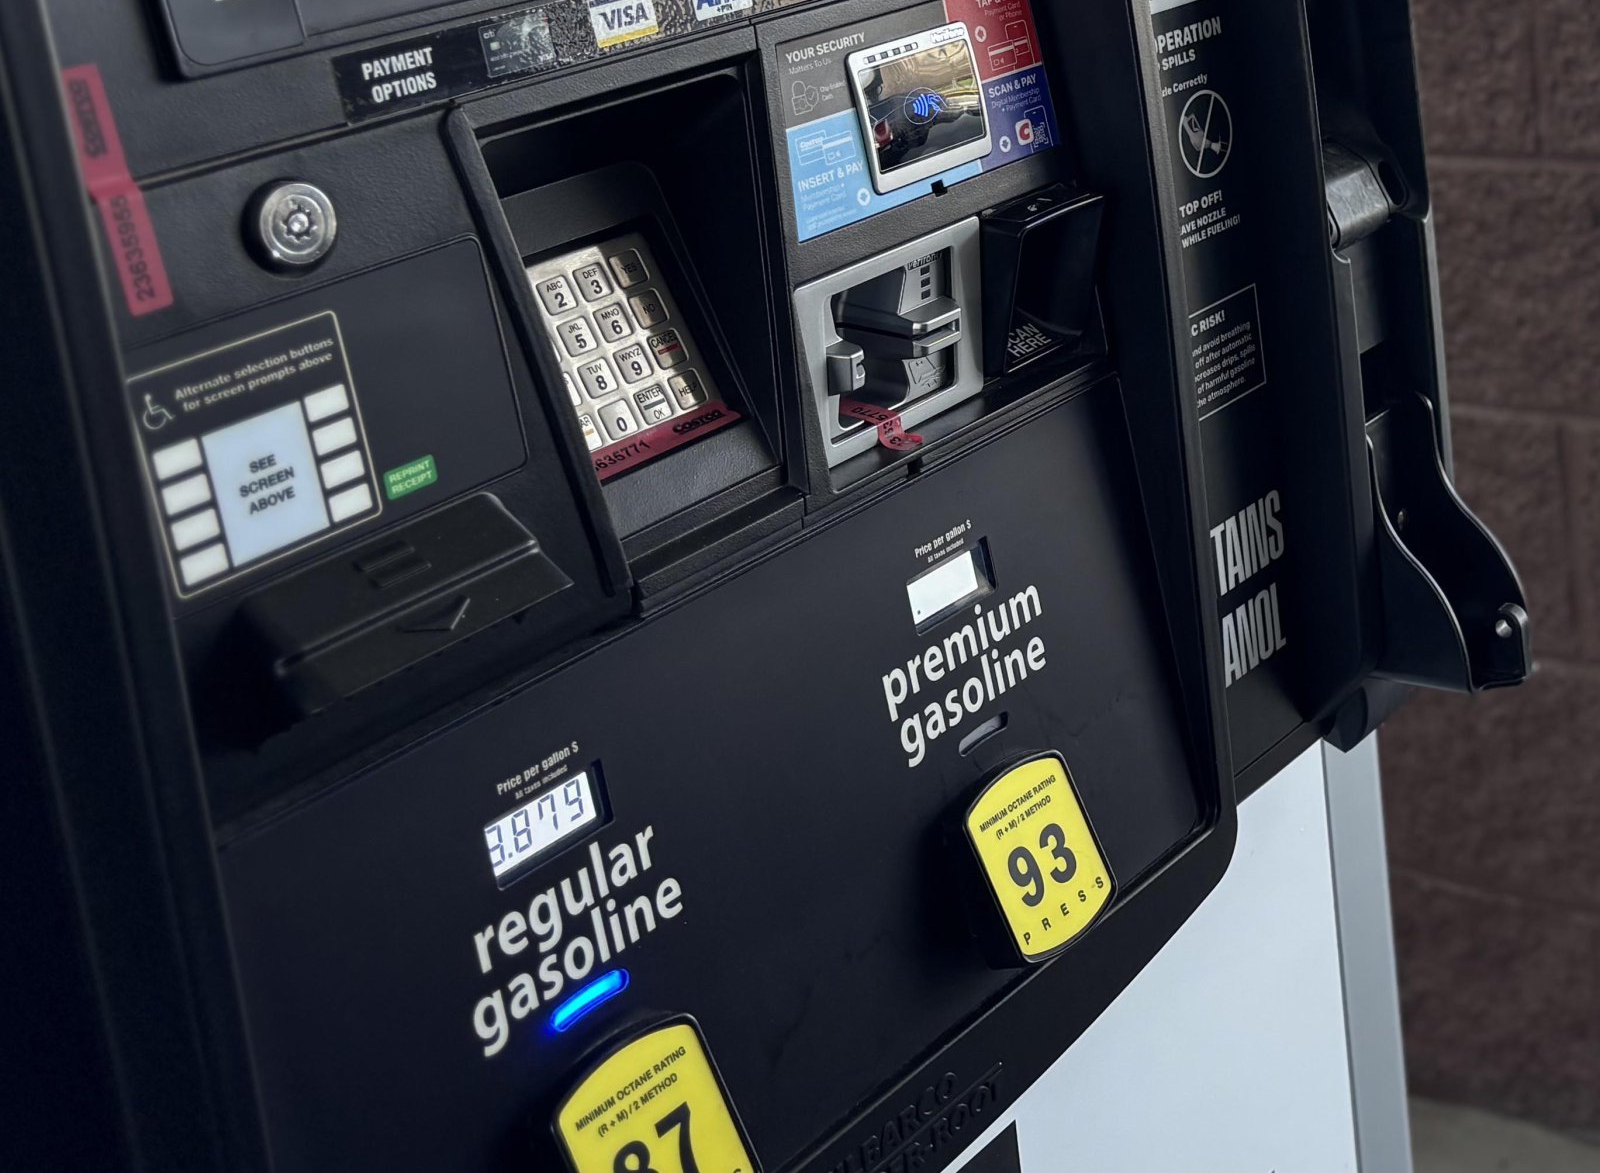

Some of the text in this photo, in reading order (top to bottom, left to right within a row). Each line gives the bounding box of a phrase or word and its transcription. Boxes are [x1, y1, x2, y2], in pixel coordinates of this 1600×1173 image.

[601, 1, 648, 34] VISA
[361, 47, 433, 80] PAYMENT
[785, 32, 866, 65] YOUR SECURITY
[1161, 48, 1196, 72] SPILLS
[371, 73, 437, 104] OPTIONS
[988, 73, 1037, 99] SCAN PAY
[1172, 73, 1208, 94] Correctly
[797, 160, 864, 193] INSERT & PAY
[1179, 189, 1223, 218] TOP OFF!
[1197, 207, 1227, 226] NOZZLE
[1181, 214, 1241, 249] WHILE FUELING!
[582, 261, 637, 280] DEF YES
[546, 280, 656, 316] ABC NO
[590, 279, 604, 295] 3
[554, 292, 620, 321] 2 MNO
[1200, 309, 1226, 333] RISK!
[567, 322, 583, 334] JKL
[610, 319, 624, 336] 6
[1203, 321, 1250, 353] avoid breathing
[576, 333, 642, 362] 5 WXYZ
[1009, 331, 1052, 358] HERE
[1205, 333, 1253, 364] after automatic
[174, 337, 334, 401] Alternate selection buttons
[182, 352, 333, 412] for screen prompts above
[586, 363, 697, 397] TUV HELP
[630, 360, 643, 376] 9
[1205, 357, 1255, 391] harmful gasoline
[595, 374, 662, 404] 8 ENTER
[616, 415, 628, 433] 0
[653, 407, 665, 419] OK
[249, 454, 277, 474] SEE
[388, 458, 431, 484] REPRINT
[239, 466, 295, 499] SCREEN
[391, 470, 433, 495] RECEIPT
[249, 486, 296, 515] ABOVE
[914, 519, 972, 559] Price per gallon $
[881, 584, 1043, 723] premium
[899, 635, 1047, 768] gasoline
[496, 741, 579, 795] Price per gallon $
[979, 774, 1056, 833] MINIMUM OCTANE RATING
[1024, 794, 1052, 818] METHOD
[1007, 822, 1077, 908] 93
[473, 824, 654, 974] regular
[473, 877, 684, 1058] gasoline
[574, 1045, 687, 1131] MINIMUM OCTANE RATING
[597, 1071, 678, 1138] (R 2 METHOD
[612, 1100, 703, 1173] 87
